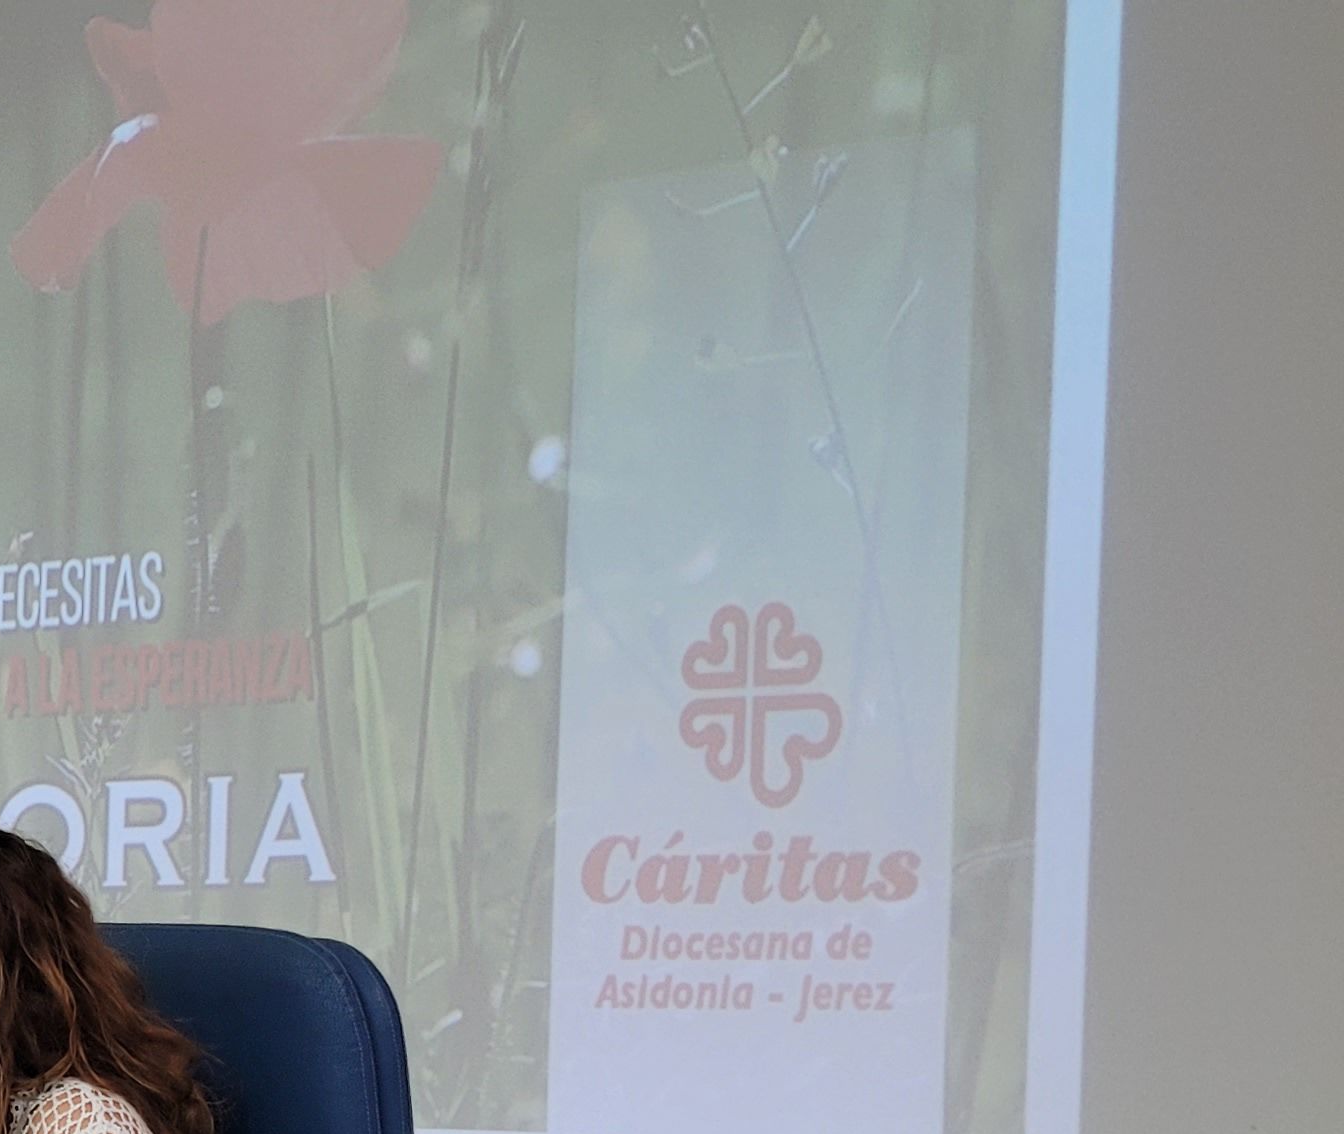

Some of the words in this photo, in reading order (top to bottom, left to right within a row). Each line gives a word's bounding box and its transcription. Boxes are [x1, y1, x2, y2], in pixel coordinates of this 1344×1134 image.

[4, 655, 30, 719] A
[35, 647, 85, 716] LA
[90, 630, 315, 713] ESPERANZA
[580, 829, 922, 905] Cáritas
[619, 924, 814, 961] Diocesana
[824, 923, 873, 961] de
[594, 973, 755, 1010] Asidonia
[792, 973, 896, 1024] Jerez
